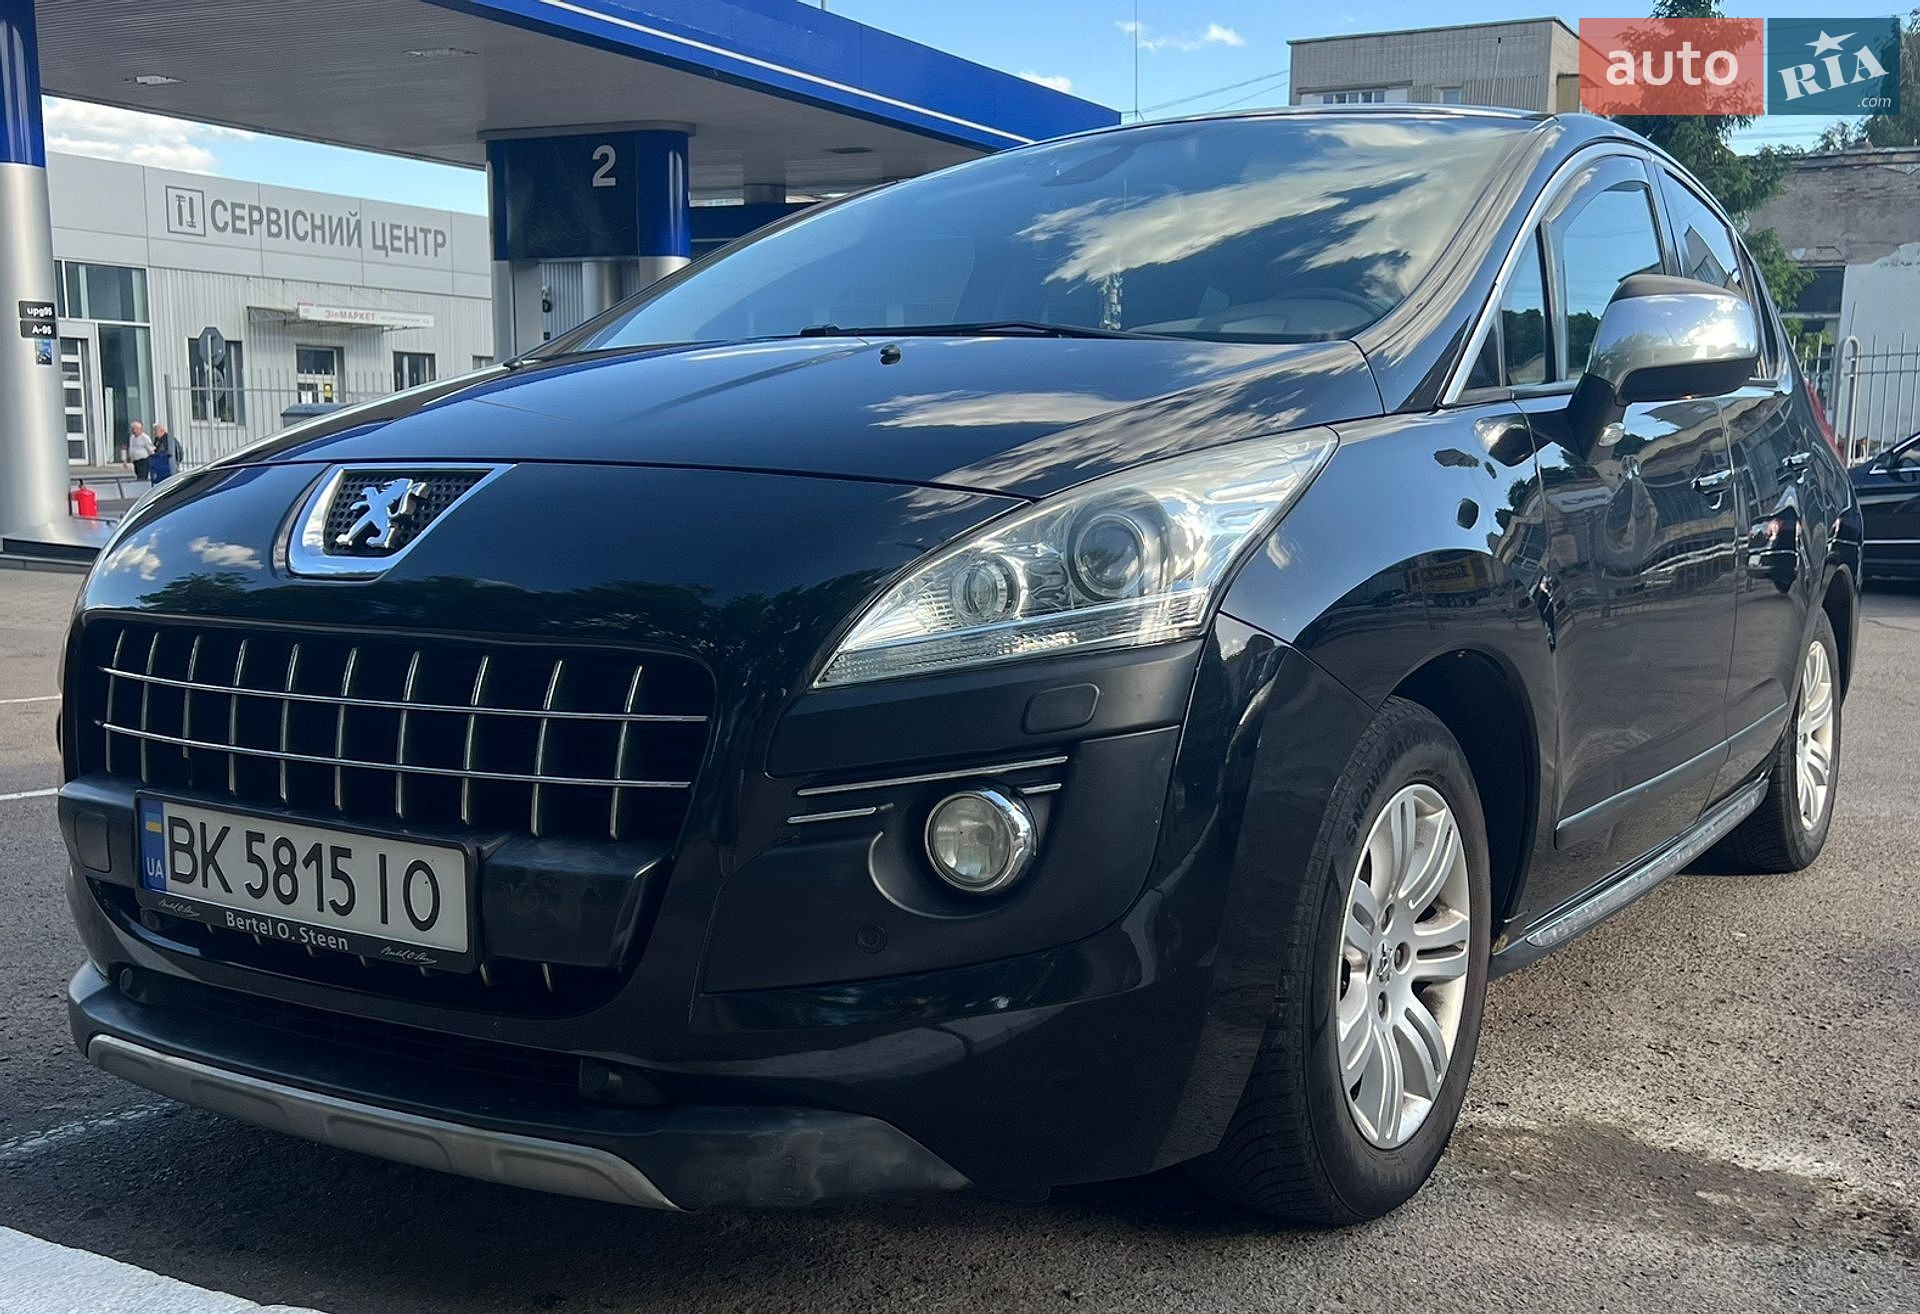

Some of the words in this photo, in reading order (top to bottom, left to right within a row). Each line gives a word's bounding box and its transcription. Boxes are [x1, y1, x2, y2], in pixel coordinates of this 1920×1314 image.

[592, 144, 617, 187] 2
[210, 198, 363, 249] СЕРВІСНИЙ
[371, 220, 447, 258] ЦЕНТР
[146, 856, 164, 880] UA
[167, 816, 233, 894] BK
[244, 830, 357, 917] 5815
[378, 852, 441, 933] IO
[225, 910, 274, 938] Bertel
[277, 922, 296, 941] O.
[300, 927, 349, 952] Steen
